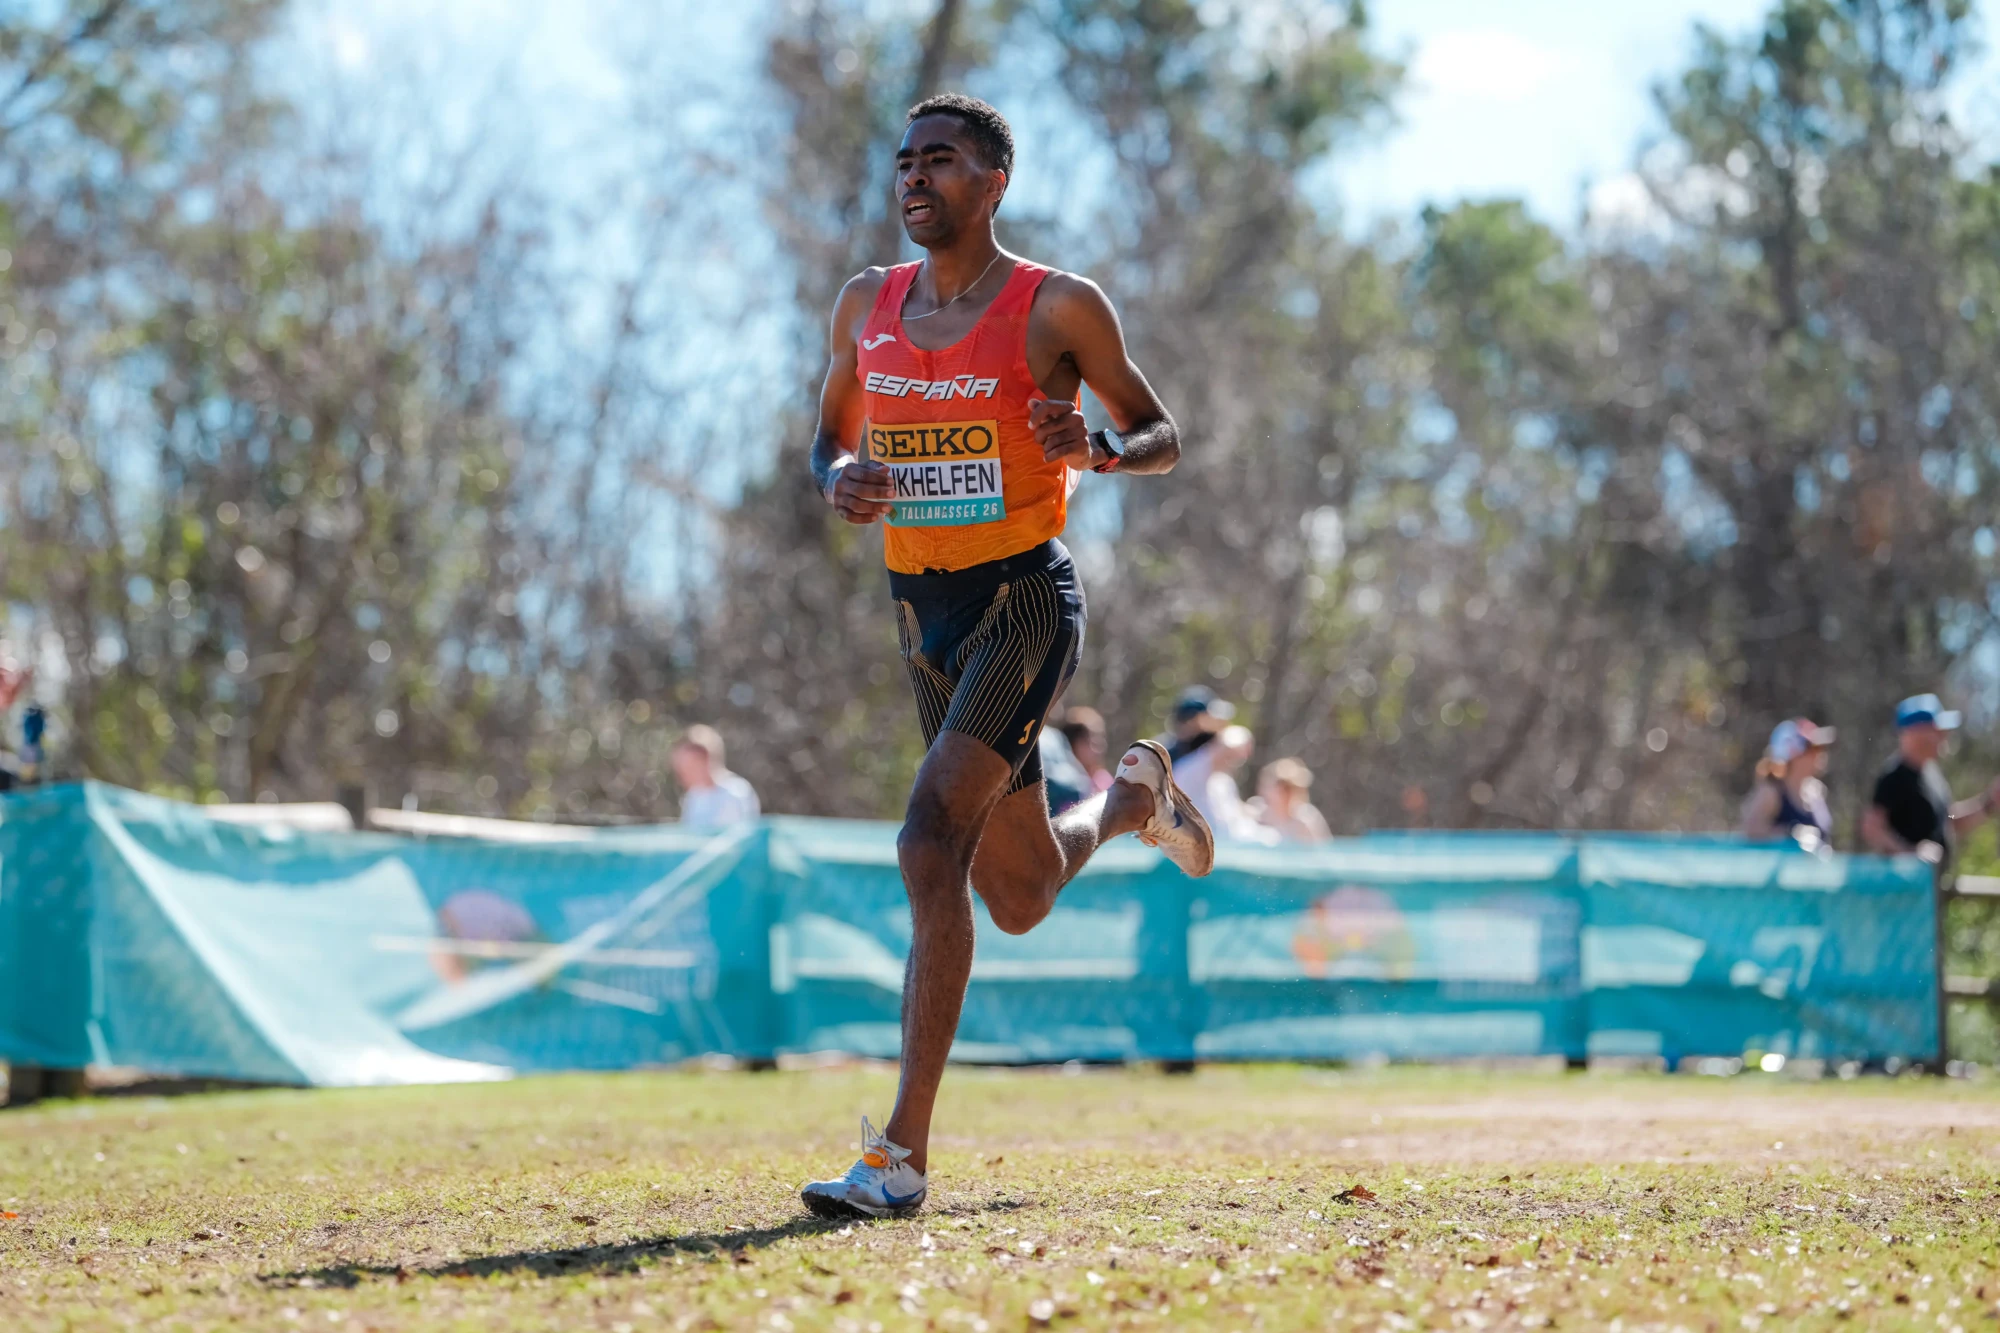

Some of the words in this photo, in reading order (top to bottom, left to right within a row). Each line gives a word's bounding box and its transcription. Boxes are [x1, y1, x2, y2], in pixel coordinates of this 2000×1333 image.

[865, 371, 999, 400] ESPAÑA
[871, 425, 993, 458] SEIKO
[901, 504, 977, 520] TALLAHASSEE
[983, 502, 998, 516] 26
